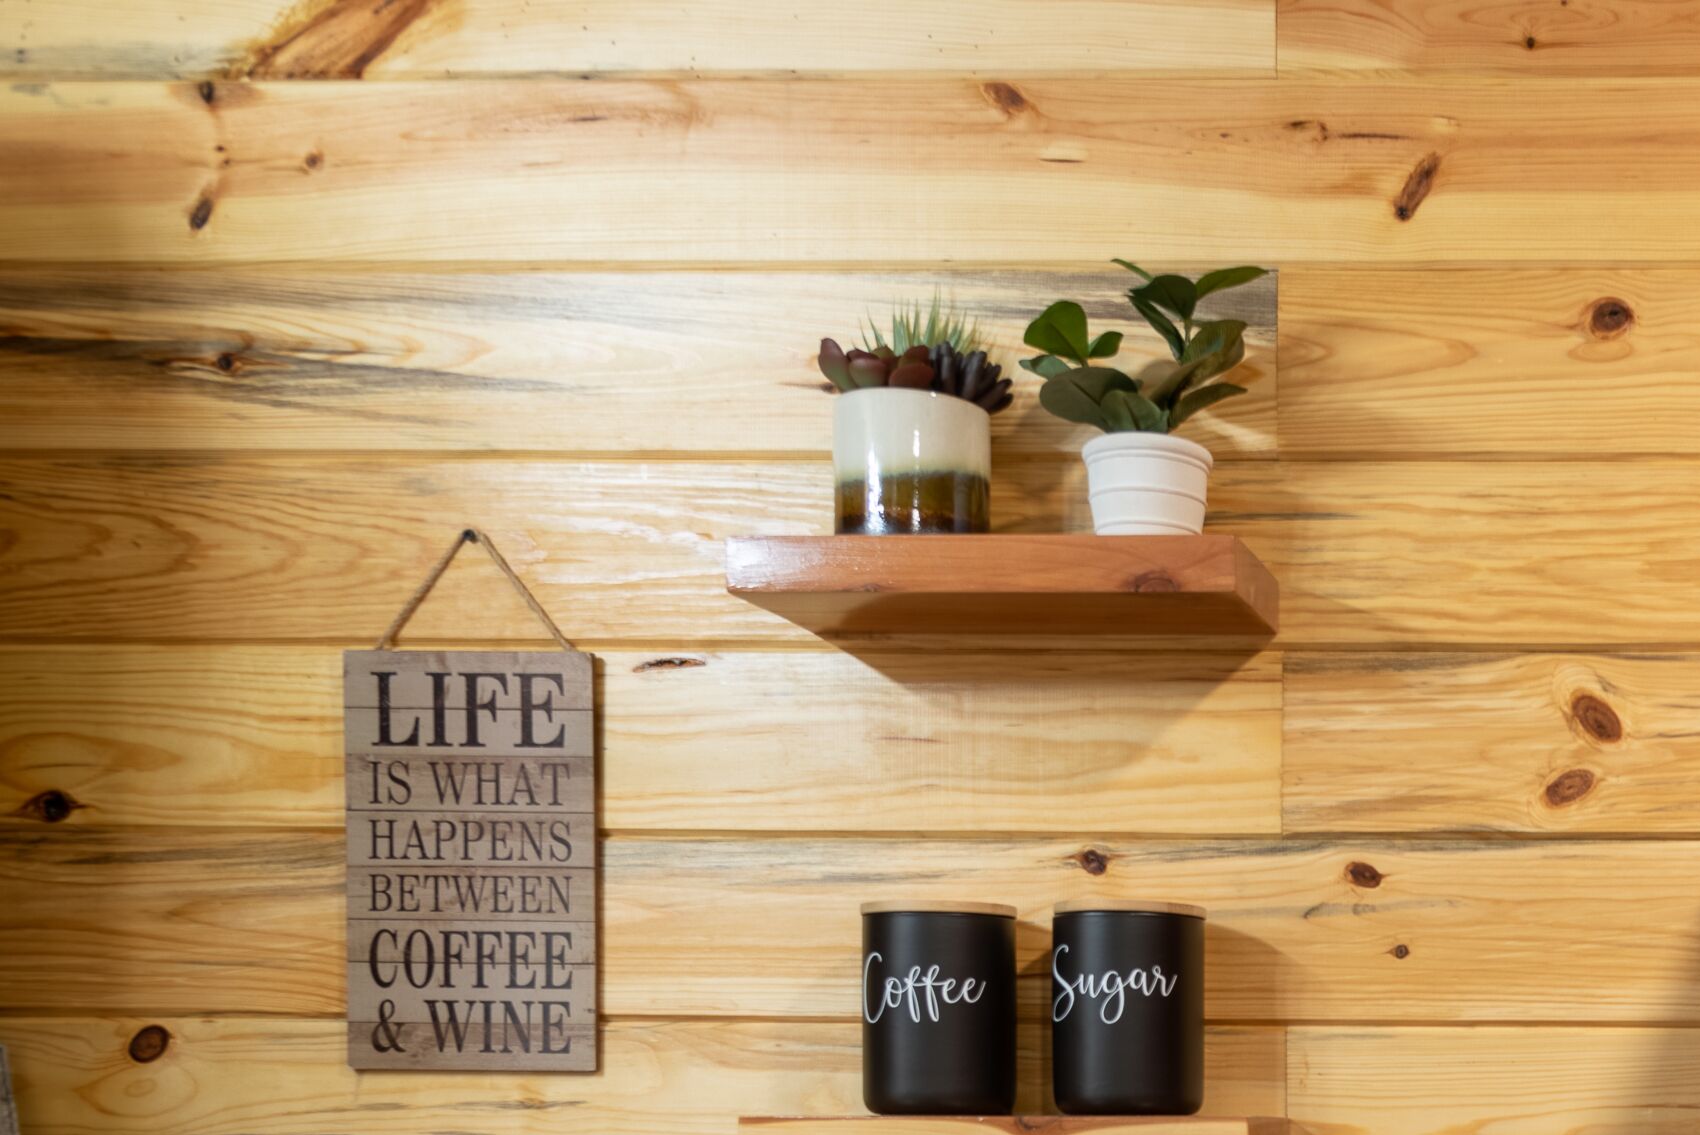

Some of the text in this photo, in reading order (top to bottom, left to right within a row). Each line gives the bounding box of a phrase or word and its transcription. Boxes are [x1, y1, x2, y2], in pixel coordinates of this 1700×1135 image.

[370, 671, 566, 749] LIFE
[368, 761, 572, 807] IS WHAT
[368, 819, 573, 863] HAPPENS
[368, 873, 573, 914] BETWEEN
[368, 928, 574, 991] COFFEE
[862, 951, 987, 1024] Coffee
[1051, 943, 1178, 1025] Sugar
[371, 998, 573, 1056] & WINE
